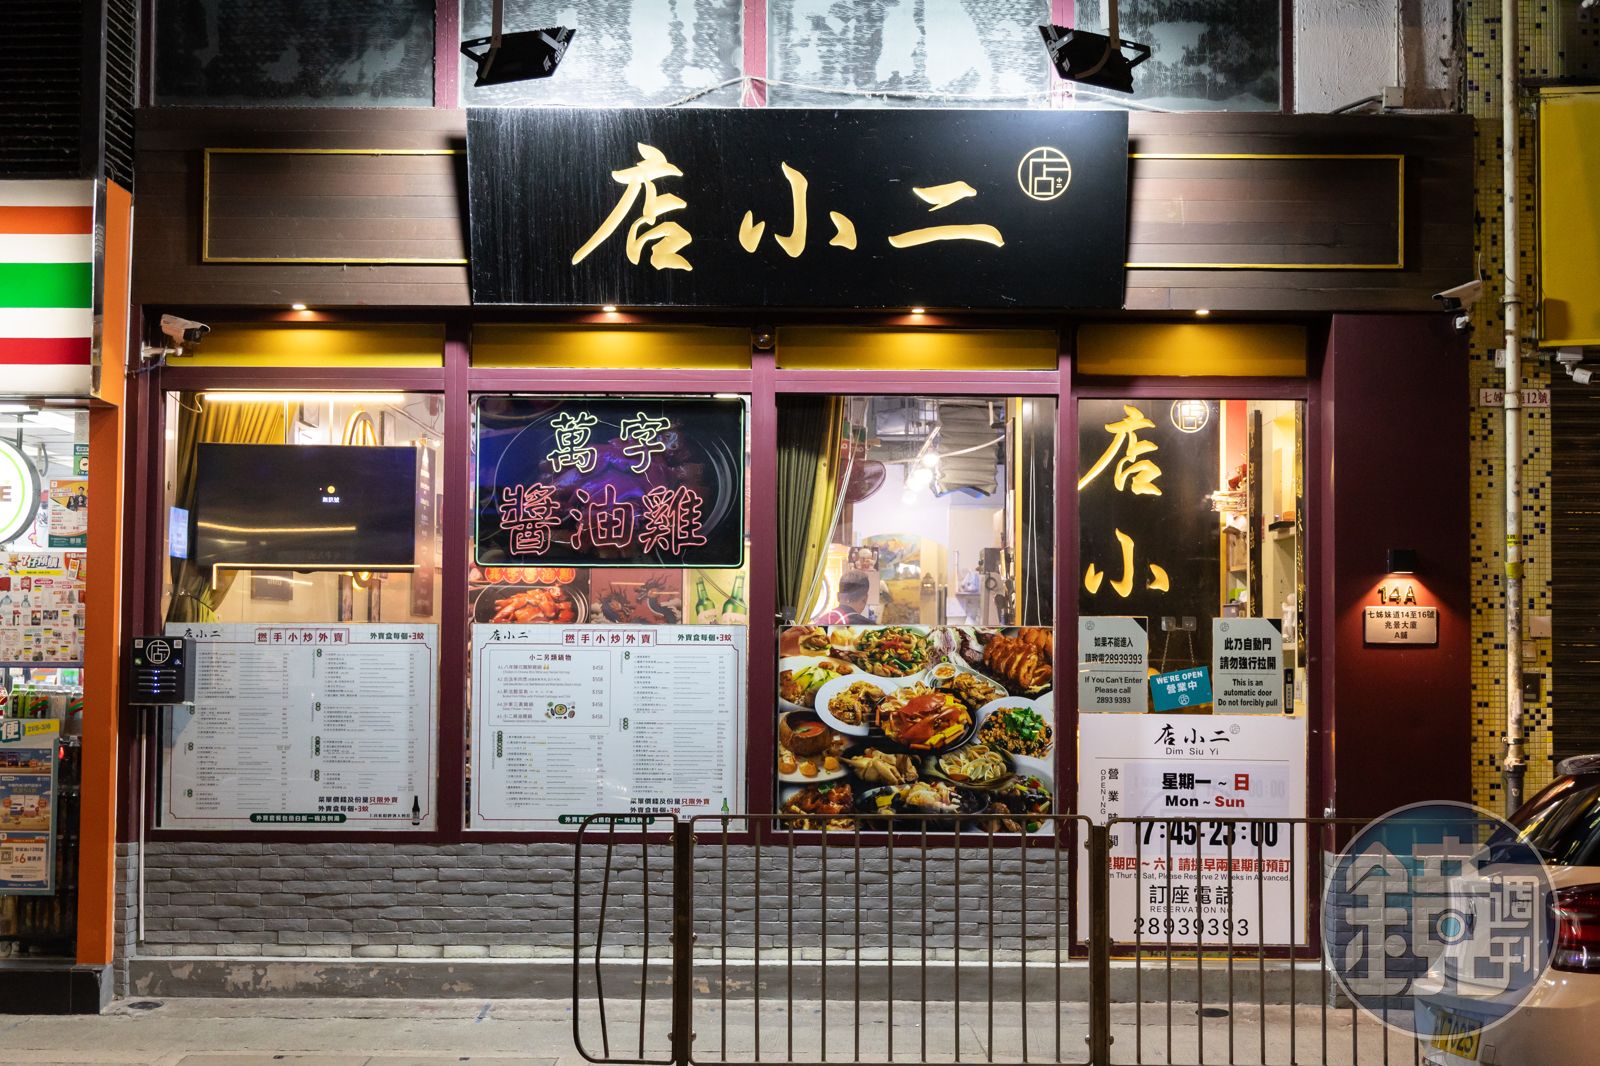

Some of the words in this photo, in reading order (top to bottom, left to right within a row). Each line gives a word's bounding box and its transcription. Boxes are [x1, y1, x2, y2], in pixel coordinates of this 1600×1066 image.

[571, 142, 1006, 272] 店小二
[547, 412, 671, 474] 萬字
[499, 482, 707, 556] 醬油雞
[1377, 585, 1417, 605] 14A
[1367, 610, 1435, 619] 七姊妹道14至16號
[1384, 621, 1417, 630] 兆景大廈
[489, 629, 529, 641] 店小二
[1094, 637, 1134, 648] 如果不能進入
[1224, 638, 1272, 650] 此乃自動門
[1085, 653, 1143, 665] 請致電28939393
[1220, 656, 1276, 670] 請勿強行拉開
[1085, 676, 1089, 684] If
[1092, 676, 1104, 684] You
[1105, 676, 1122, 684] Can't
[1124, 676, 1142, 684] Enter
[1156, 674, 1180, 685] WE'RE
[1181, 671, 1203, 680] OPEN
[1232, 679, 1246, 687] This
[1249, 679, 1254, 687] is
[1166, 682, 1198, 695] 營業中
[1258, 689, 1272, 697] door
[1240, 698, 1263, 708] forcibly
[1265, 699, 1278, 708] pull
[1154, 723, 1230, 746] 店小二
[1165, 747, 1184, 756] Dim
[1189, 747, 1204, 756] Siu
[1209, 747, 1219, 756] Yi
[1162, 773, 1211, 790] 星期一
[1234, 773, 1249, 791] 日
[1165, 795, 1199, 807] Mon
[1215, 796, 1245, 807] Sun
[1132, 817, 1278, 847] 7:45-23:00
[1142, 872, 1157, 880] Sat,
[1254, 873, 1290, 881] Avanced.
[1149, 885, 1233, 904] 訂座電話
[1133, 917, 1249, 936] 28939393
